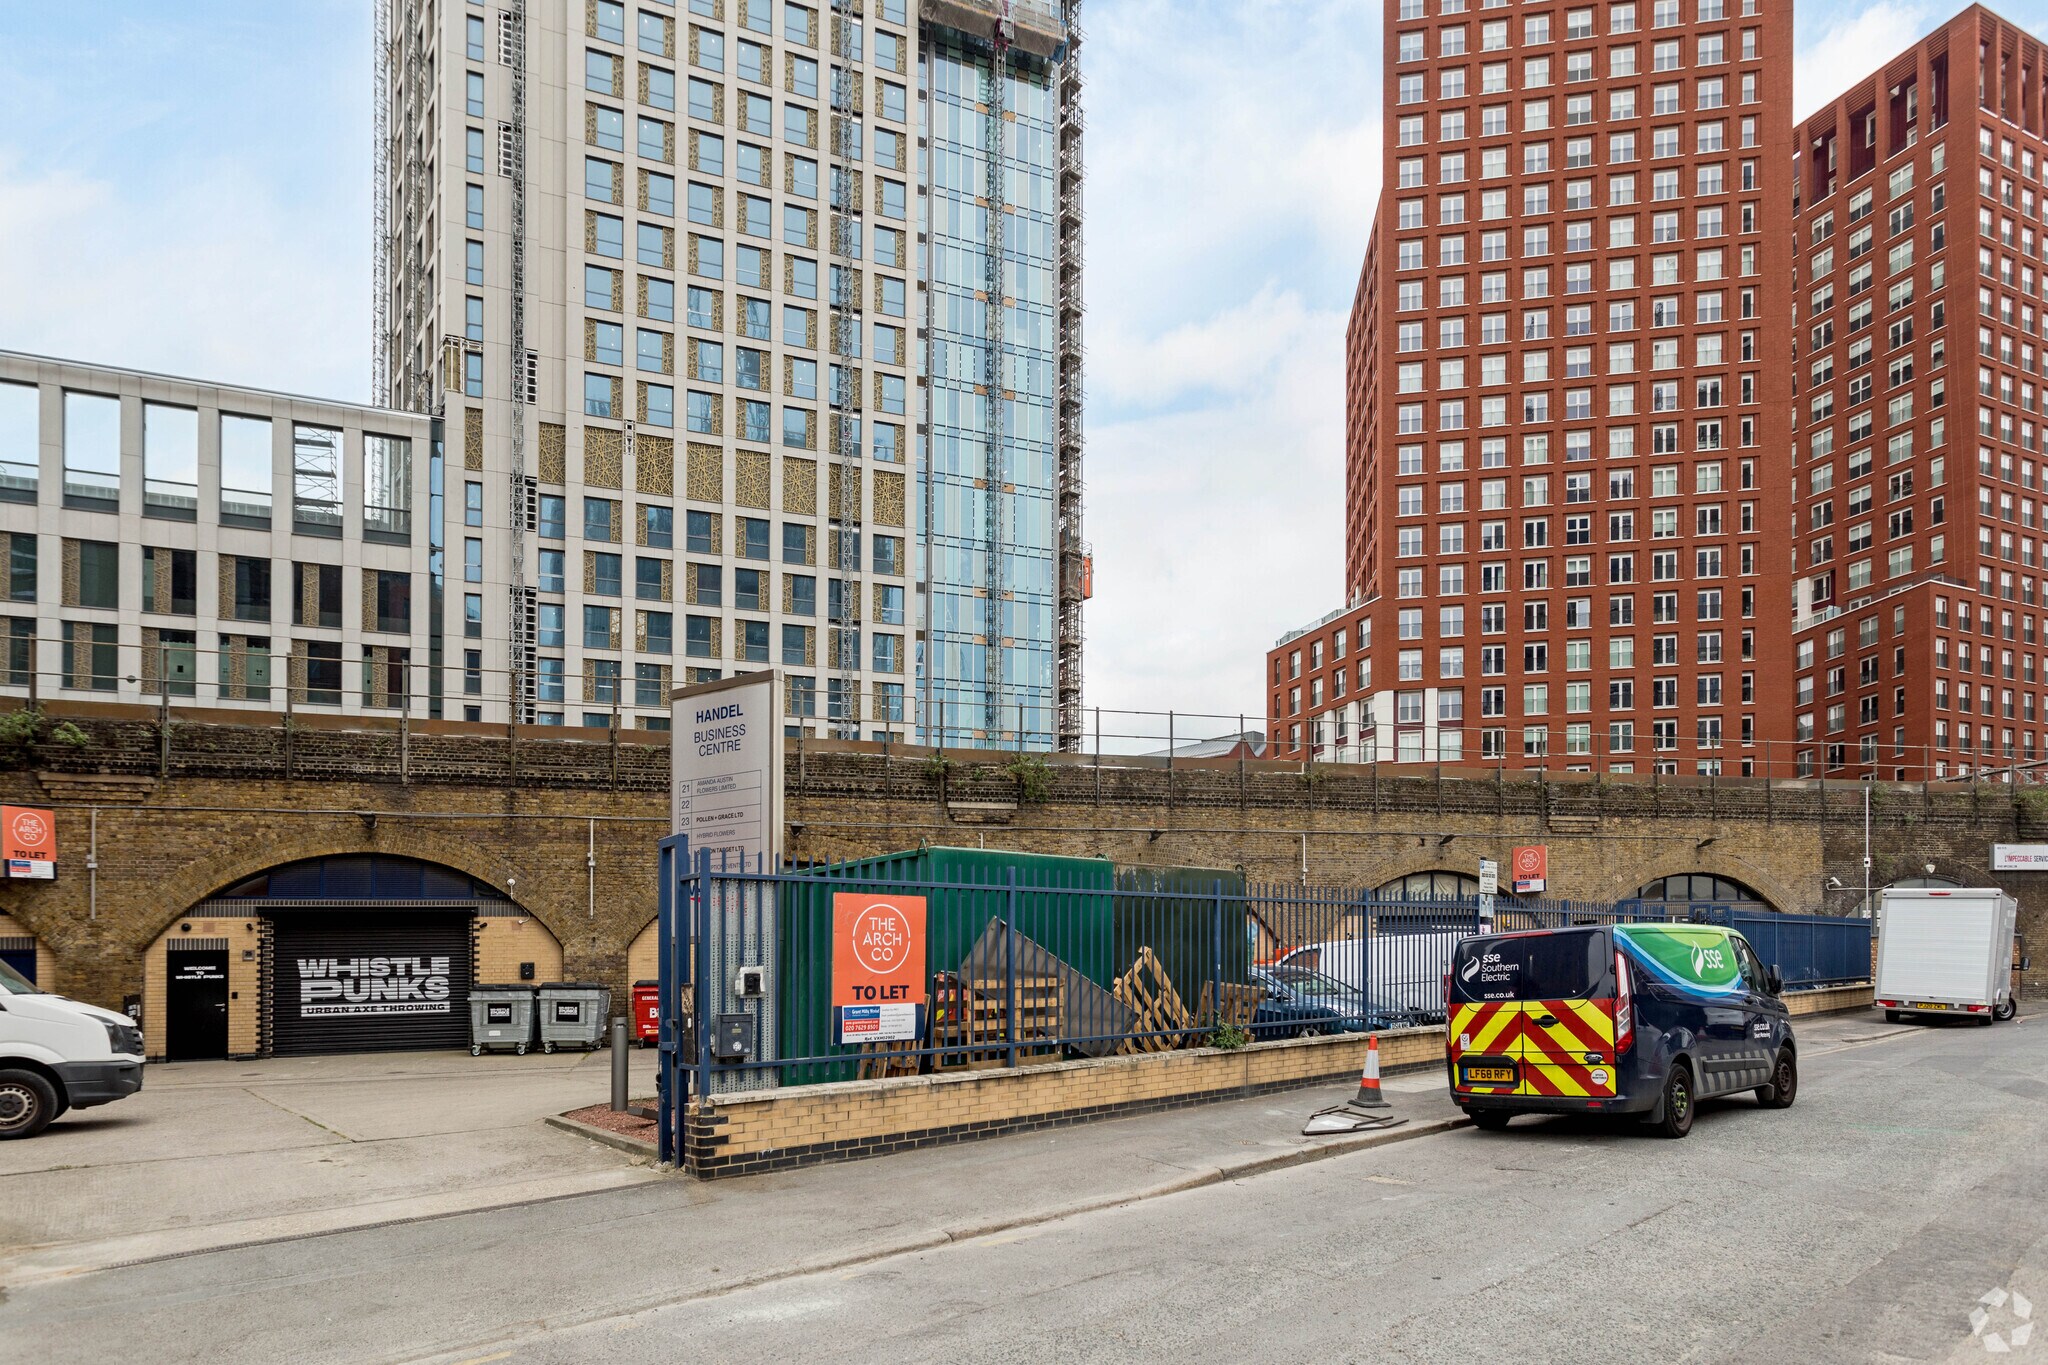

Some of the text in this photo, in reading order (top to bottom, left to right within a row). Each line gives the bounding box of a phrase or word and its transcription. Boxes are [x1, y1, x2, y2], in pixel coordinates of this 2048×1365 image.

[696, 704, 743, 723] HANDEL
[694, 724, 746, 744] BUSINESS
[699, 739, 741, 757] CENTRE
[682, 785, 689, 793] 21
[682, 800, 689, 809] 22
[681, 817, 689, 826] 23
[869, 917, 896, 931] THE
[863, 933, 901, 946] ARCH
[871, 947, 893, 961] CO
[1482, 954, 1500, 963] sse
[1704, 949, 1724, 969] sse
[297, 956, 450, 978] WHISTLE
[1482, 963, 1519, 972] Southern
[1481, 972, 1510, 982] Electric
[300, 976, 450, 1003] PUNKS
[852, 985, 909, 1000] TO LET
[382, 1004, 445, 1012] THROWING
[1470, 1070, 1511, 1079] LF68 RFY
